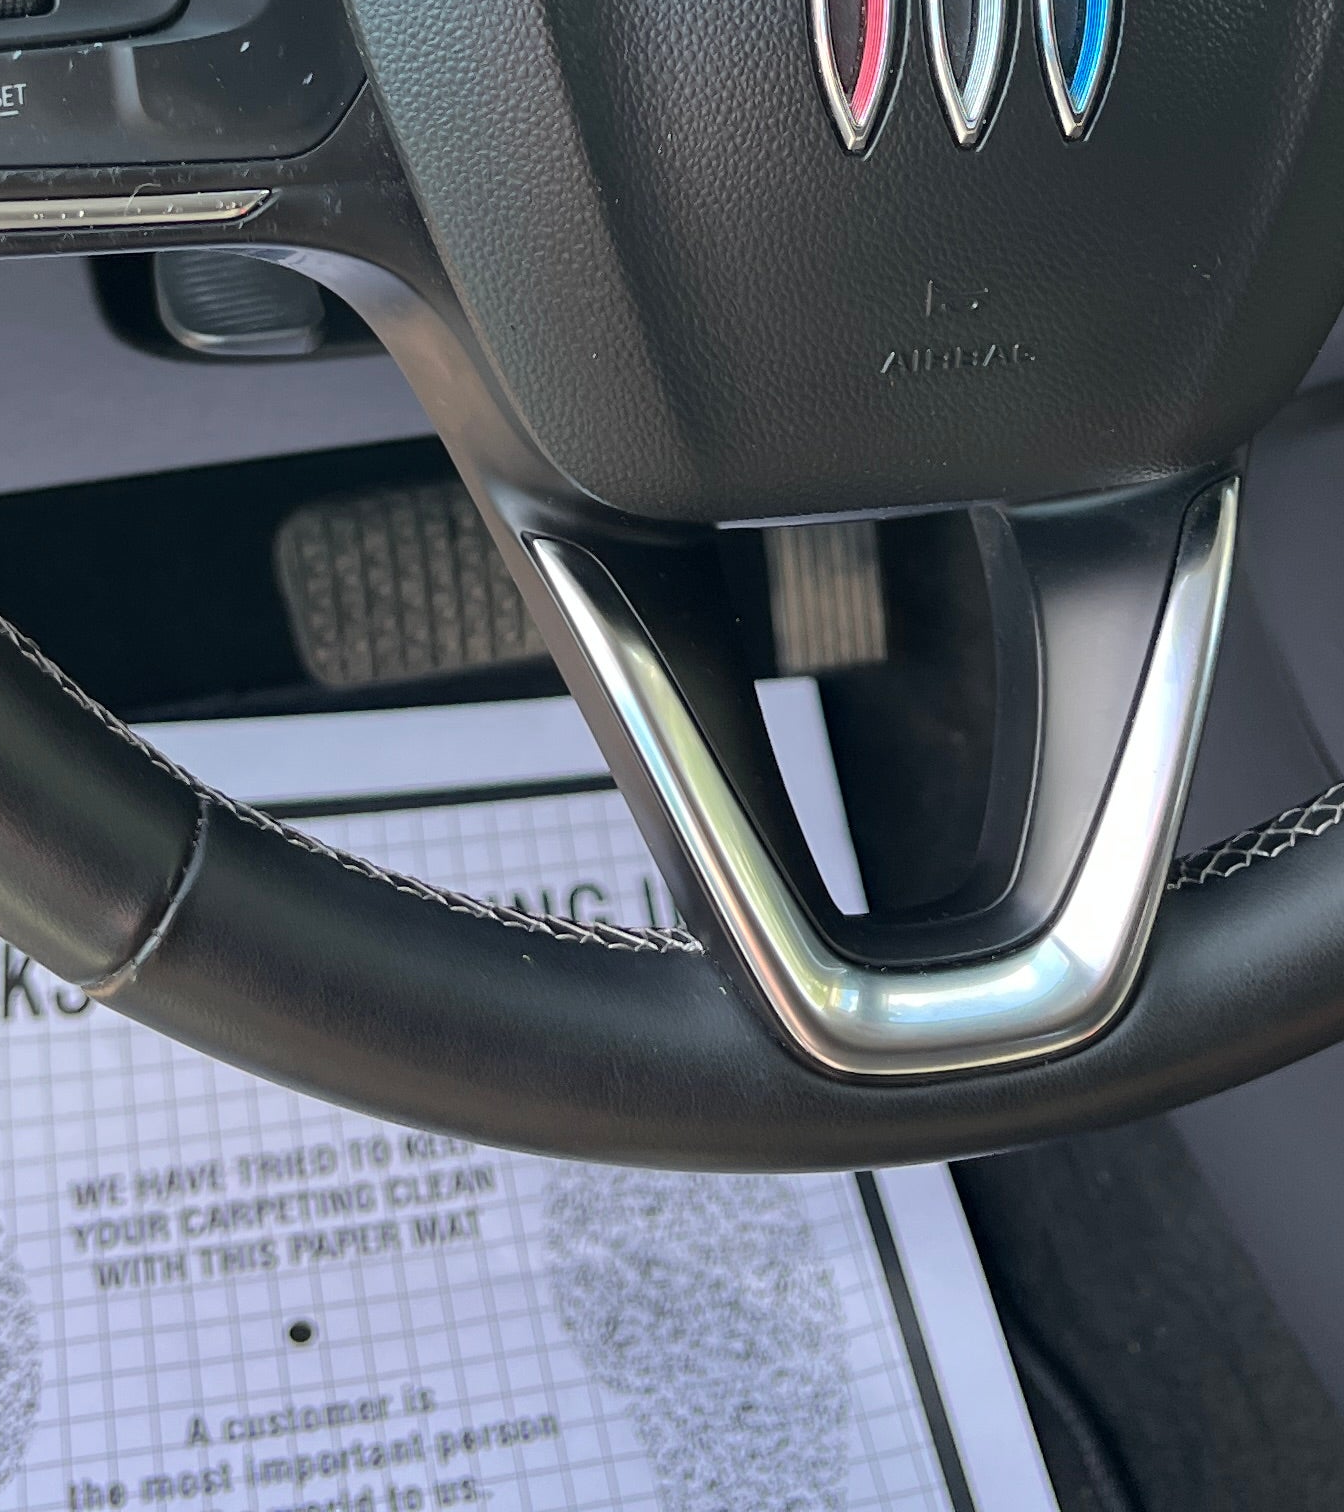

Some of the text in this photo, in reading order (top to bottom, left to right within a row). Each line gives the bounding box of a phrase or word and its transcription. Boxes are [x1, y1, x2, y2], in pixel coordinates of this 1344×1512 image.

[71, 1165, 496, 1253] YOUR CARPETING CLEAN
[72, 1173, 125, 1210] WE
[134, 1159, 225, 1202] HAVE
[236, 1143, 338, 1187] TRIED
[349, 1136, 391, 1172] TO
[94, 1208, 484, 1290] WITH THIS PAPER MAT
[188, 1384, 436, 1446] A customer is
[69, 1412, 560, 1511] the most important person
